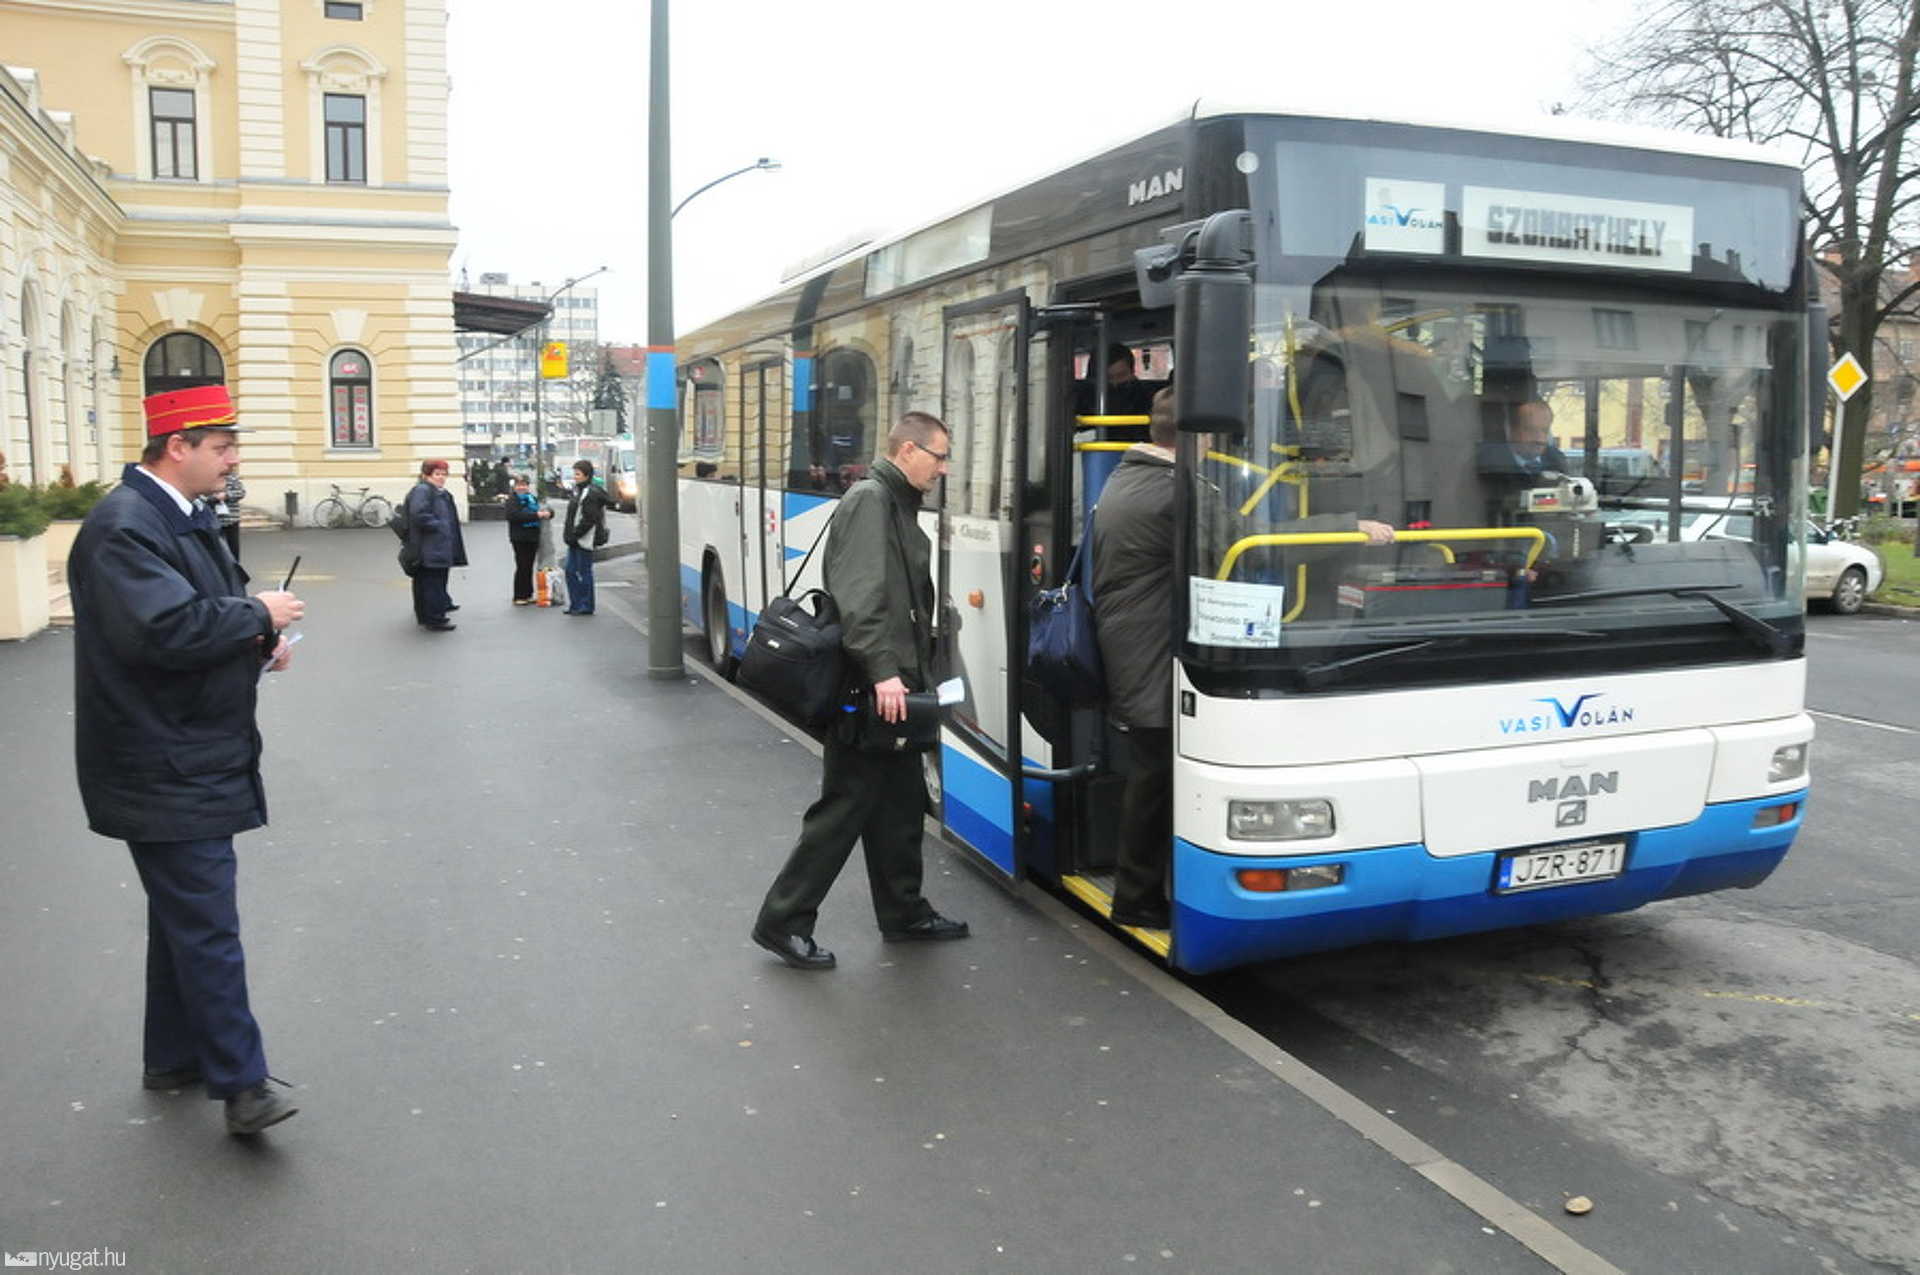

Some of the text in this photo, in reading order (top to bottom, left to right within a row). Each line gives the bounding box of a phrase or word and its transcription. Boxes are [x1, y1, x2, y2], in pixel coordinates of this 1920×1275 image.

[1128, 167, 1183, 206] MAN
[1500, 715, 1551, 734] VASI
[1528, 771, 1619, 803] MAN
[1516, 848, 1617, 882] JZR-871
